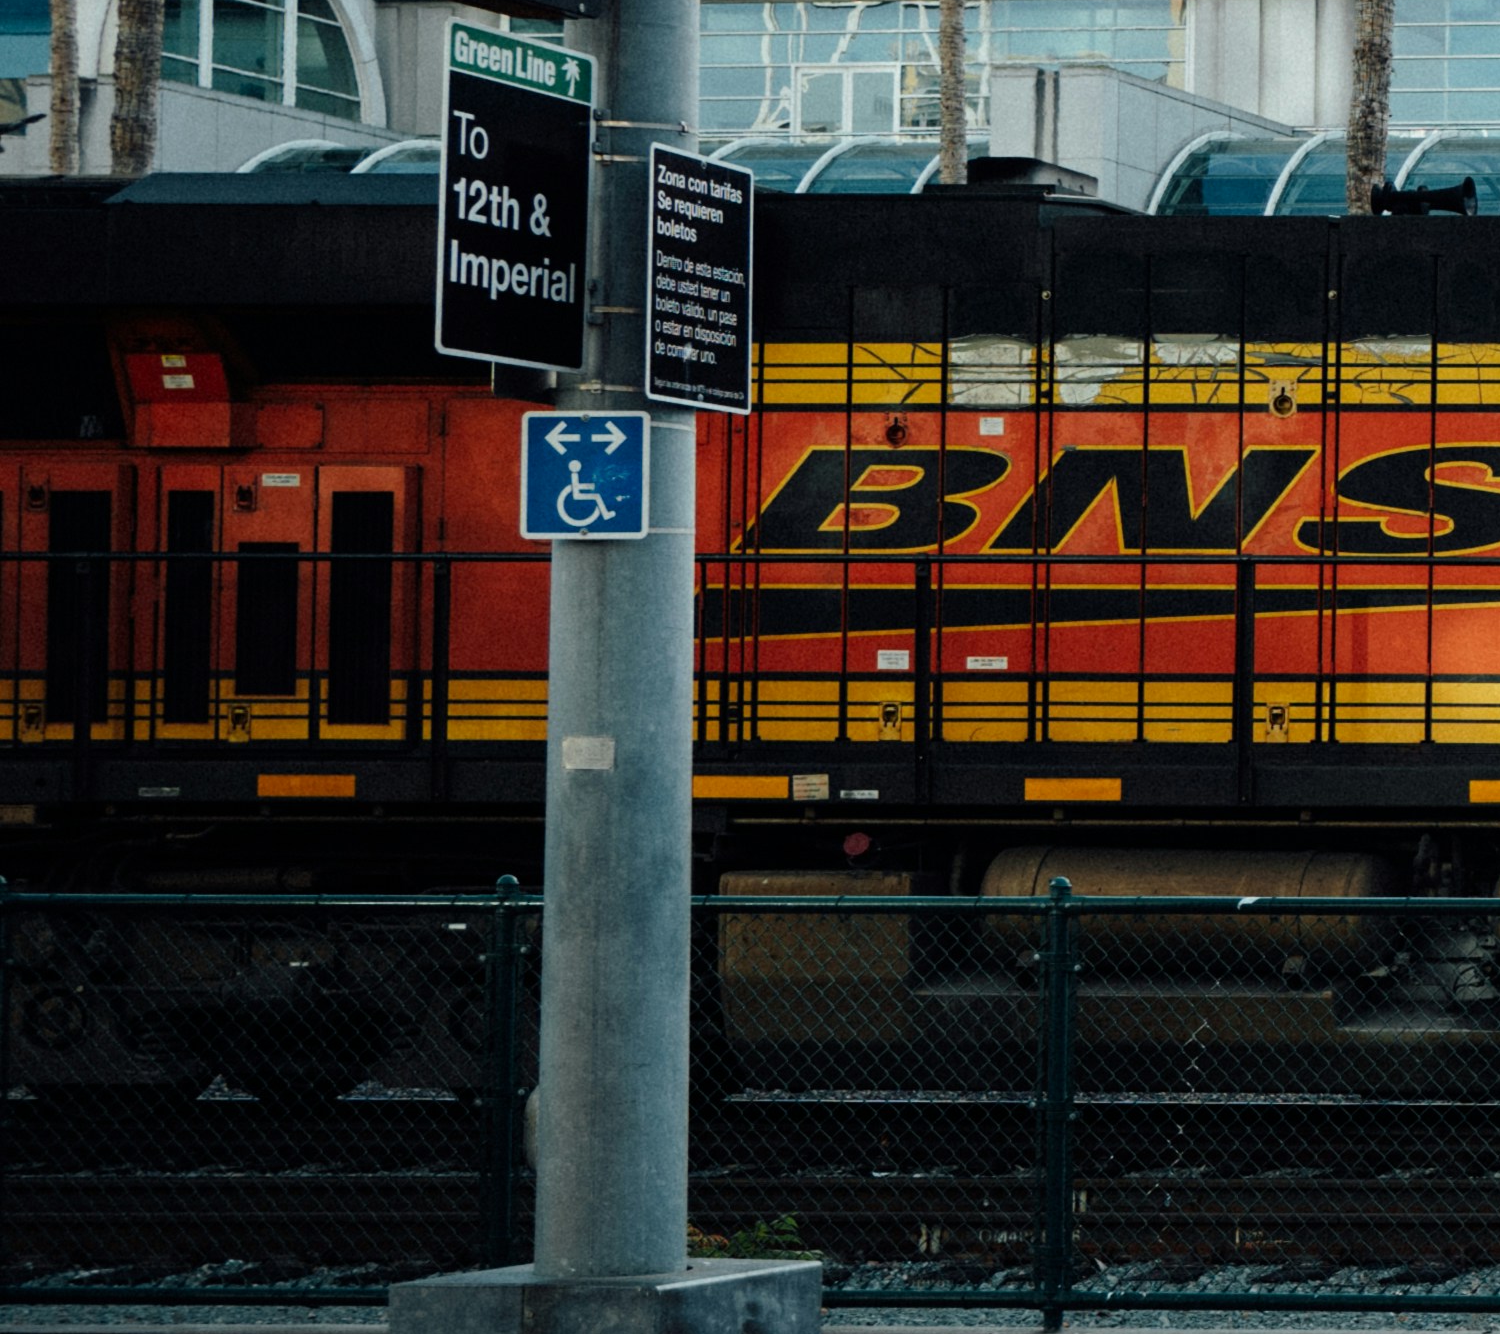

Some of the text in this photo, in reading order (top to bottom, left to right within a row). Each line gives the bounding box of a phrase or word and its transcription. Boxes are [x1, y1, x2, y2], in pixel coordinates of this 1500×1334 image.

[454, 30, 557, 87] Green Line
[453, 110, 489, 160] To
[658, 164, 743, 204] Zona con tarifas
[453, 177, 552, 237] 12th &
[657, 190, 724, 224] Se requieren
[657, 216, 697, 242] boletos
[450, 239, 576, 304] Imperial
[656, 249, 682, 271] Dentro
[684, 257, 694, 274] de
[695, 263, 711, 278] esta
[656, 273, 731, 303] debe usted tener un
[655, 294, 680, 315] boleto
[708, 308, 718, 321] un
[719, 312, 738, 327] pase
[662, 320, 682, 337] estar
[683, 326, 693, 339] en
[655, 339, 666, 355] de
